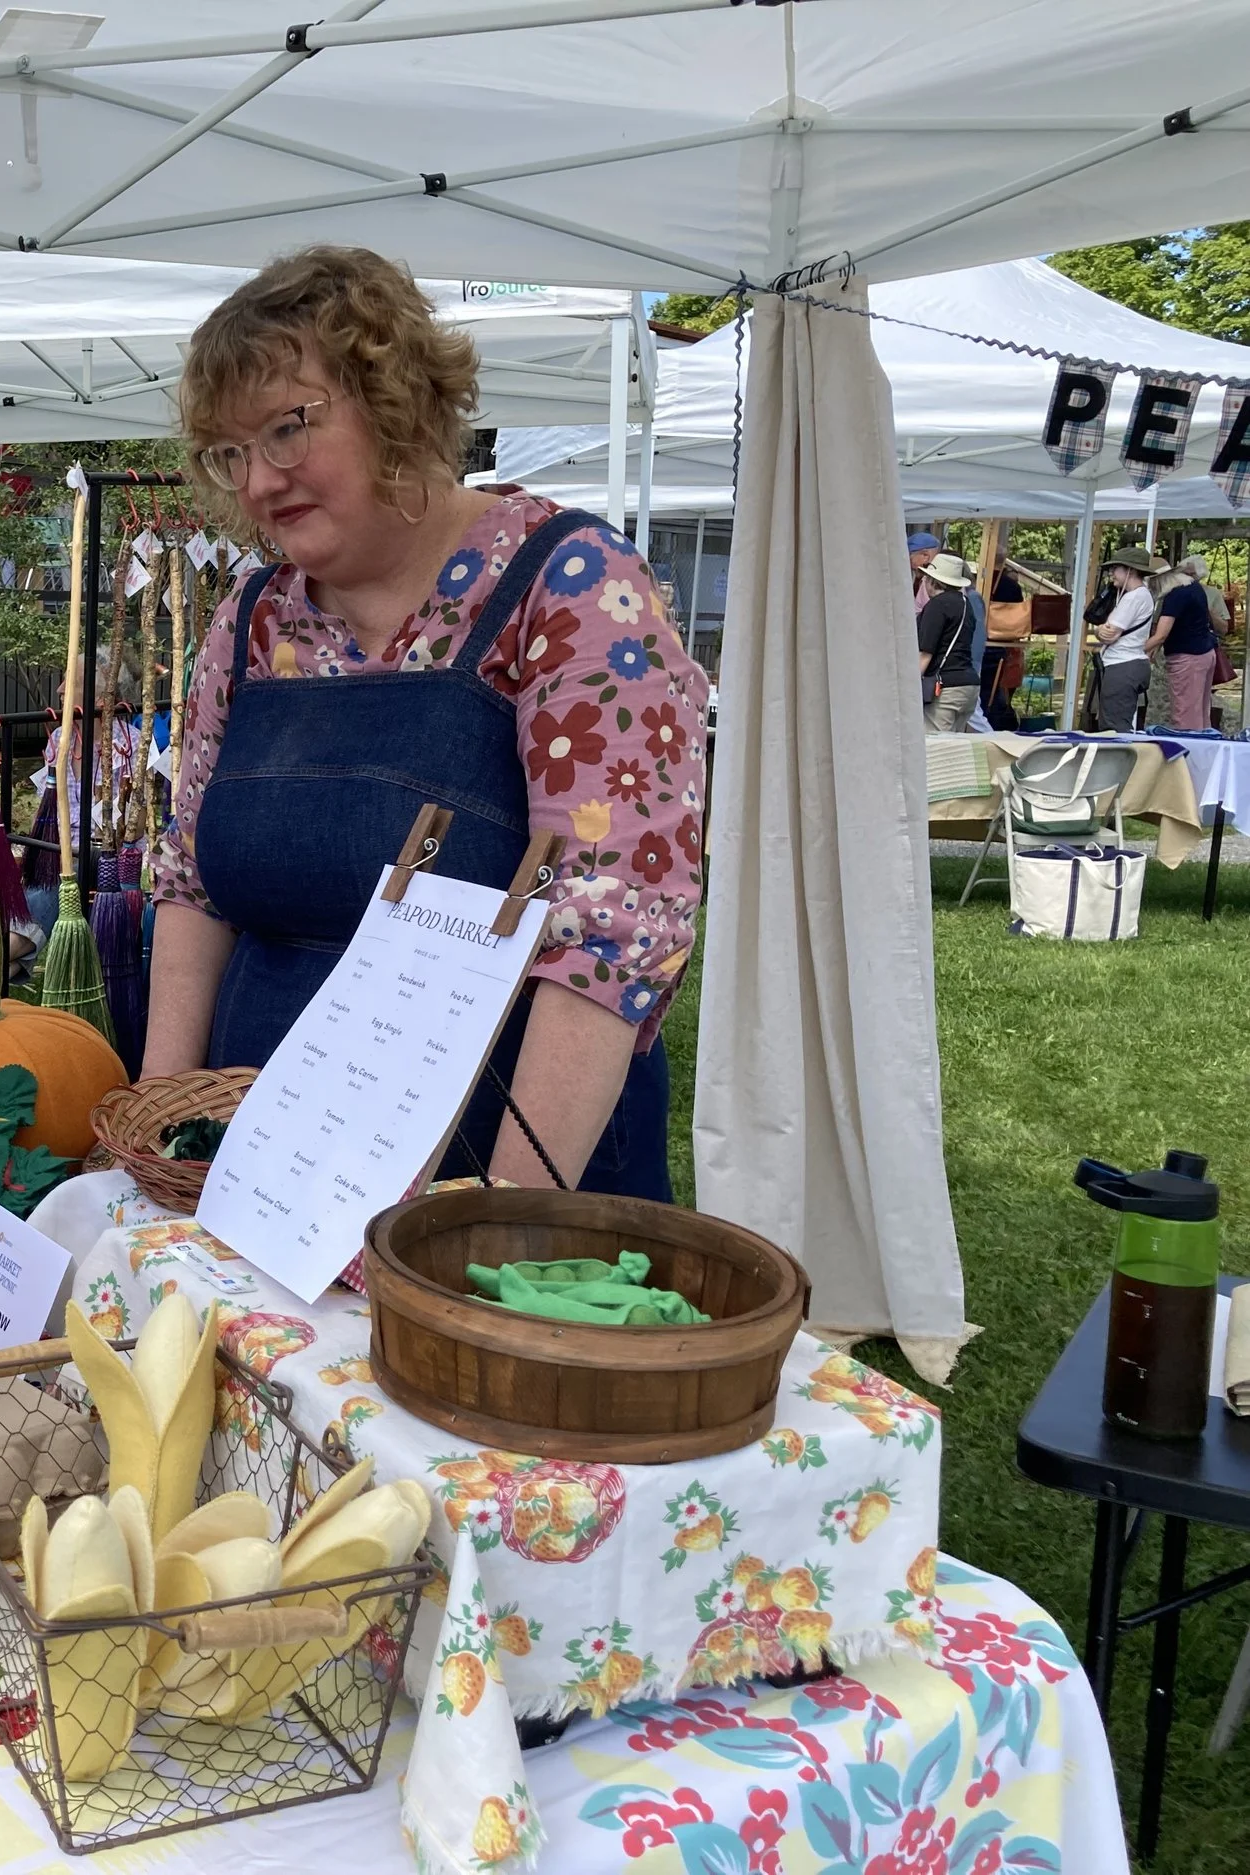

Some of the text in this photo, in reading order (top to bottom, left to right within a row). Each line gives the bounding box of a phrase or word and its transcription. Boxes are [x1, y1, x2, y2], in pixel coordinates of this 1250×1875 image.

[387, 901, 442, 930] PEAPOD
[414, 949, 429, 958] PRICE
[398, 973, 426, 989] Sandwich
[450, 990, 475, 1005] Pea Pod
[329, 999, 350, 1013] Pumpkin
[371, 1017, 402, 1036] Egg Single
[303, 1041, 328, 1059] Cabbage
[426, 1039, 448, 1054] Pickles
[346, 1061, 379, 1082] Egg Carton
[281, 1085, 301, 1100] Squash
[324, 1109, 345, 1125] Tomato
[253, 1127, 271, 1141] Carrot
[373, 1133, 395, 1150] Cookie
[293, 1150, 316, 1168] Broccoli
[334, 1174, 366, 1198] Cake Slice
[253, 1186, 274, 1205] Rainbow
[273, 1200, 292, 1215] Chard
[309, 1223, 320, 1234] Pie
